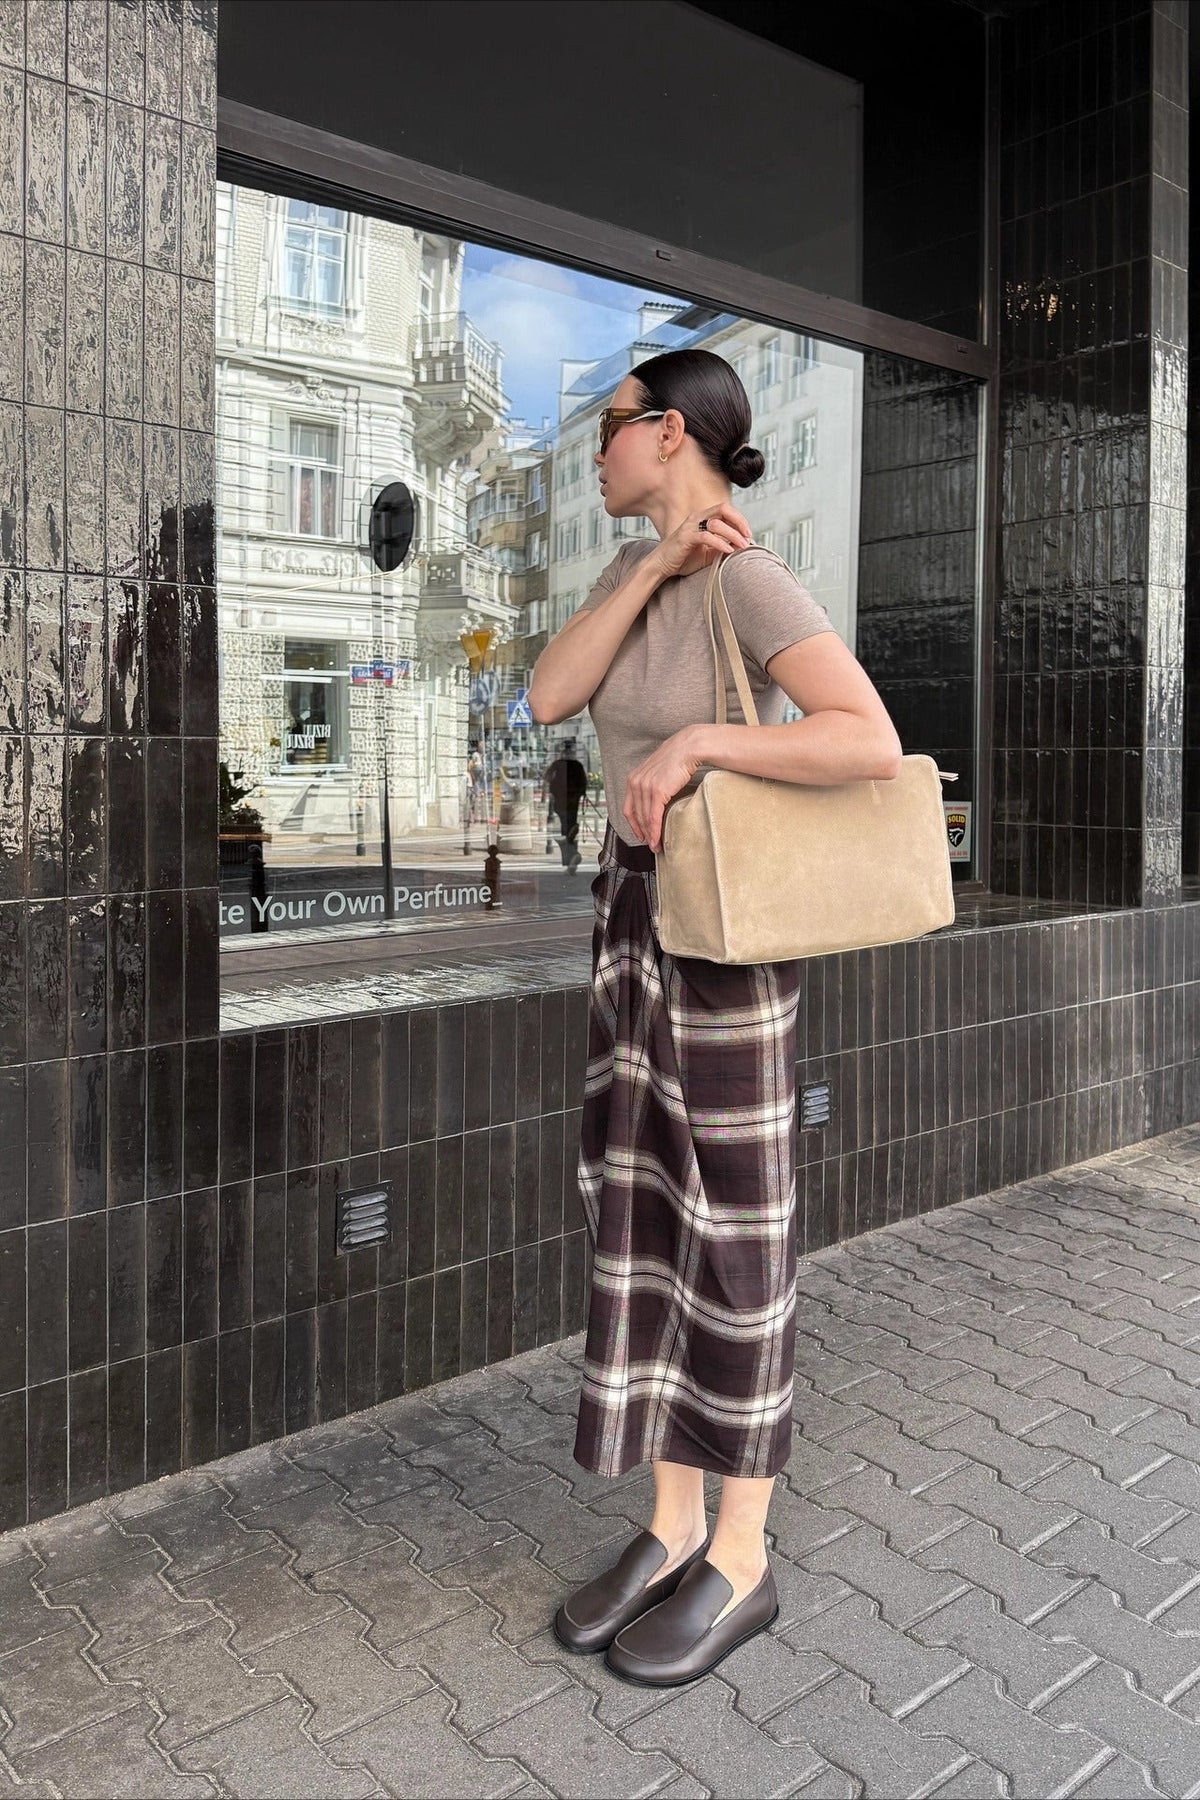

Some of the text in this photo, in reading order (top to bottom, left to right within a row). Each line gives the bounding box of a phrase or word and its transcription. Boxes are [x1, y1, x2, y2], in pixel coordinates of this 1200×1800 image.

[948, 815, 965, 823] SOLID
[251, 895, 317, 922] Your
[323, 891, 385, 917] Own
